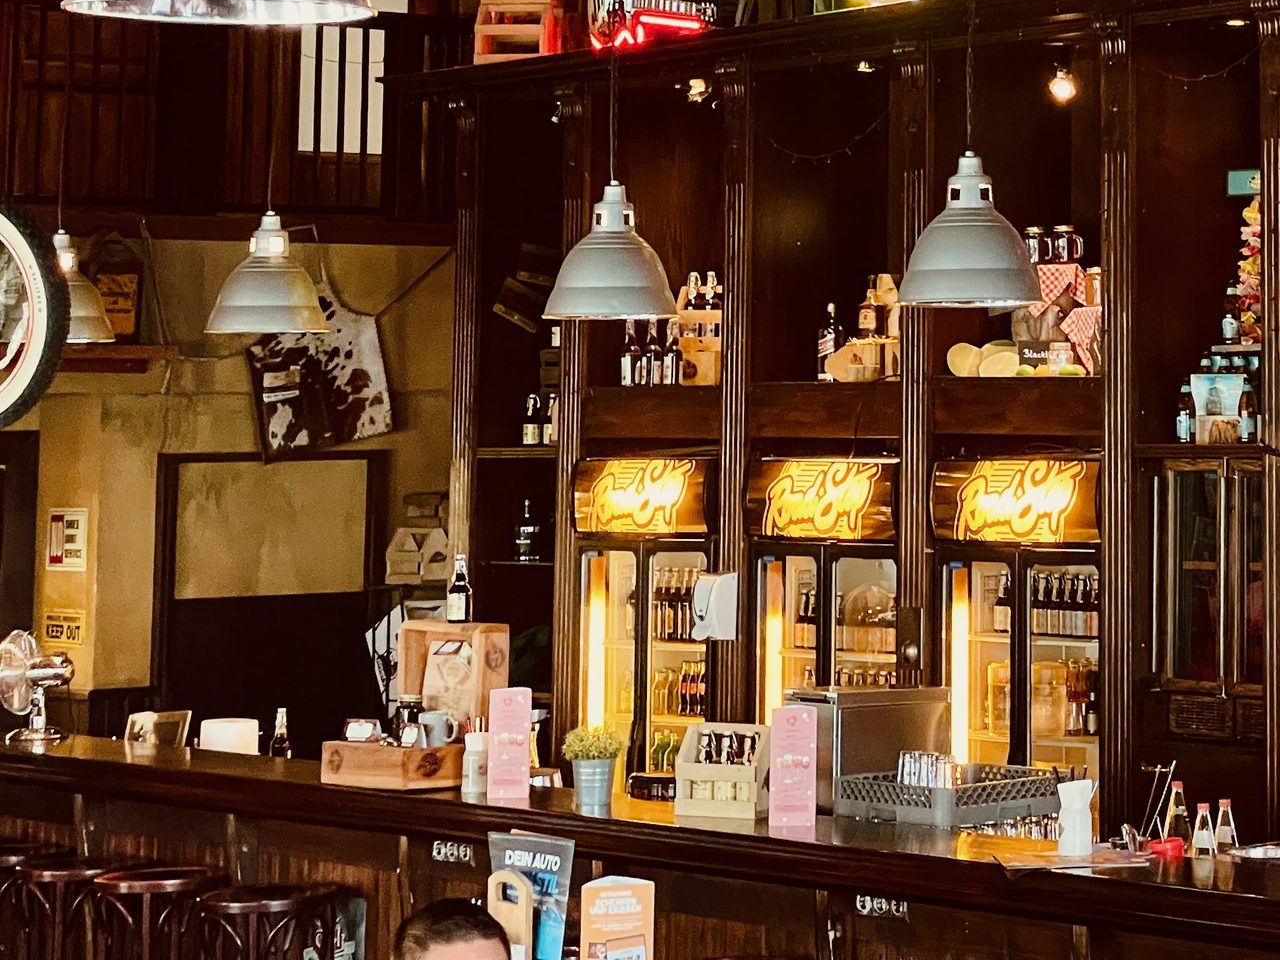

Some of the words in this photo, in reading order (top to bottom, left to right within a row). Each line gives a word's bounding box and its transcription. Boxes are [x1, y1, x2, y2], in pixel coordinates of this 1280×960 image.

[66, 625, 81, 641] OUT
[504, 850, 533, 867] DEIN
[533, 853, 561, 871] AUTO
